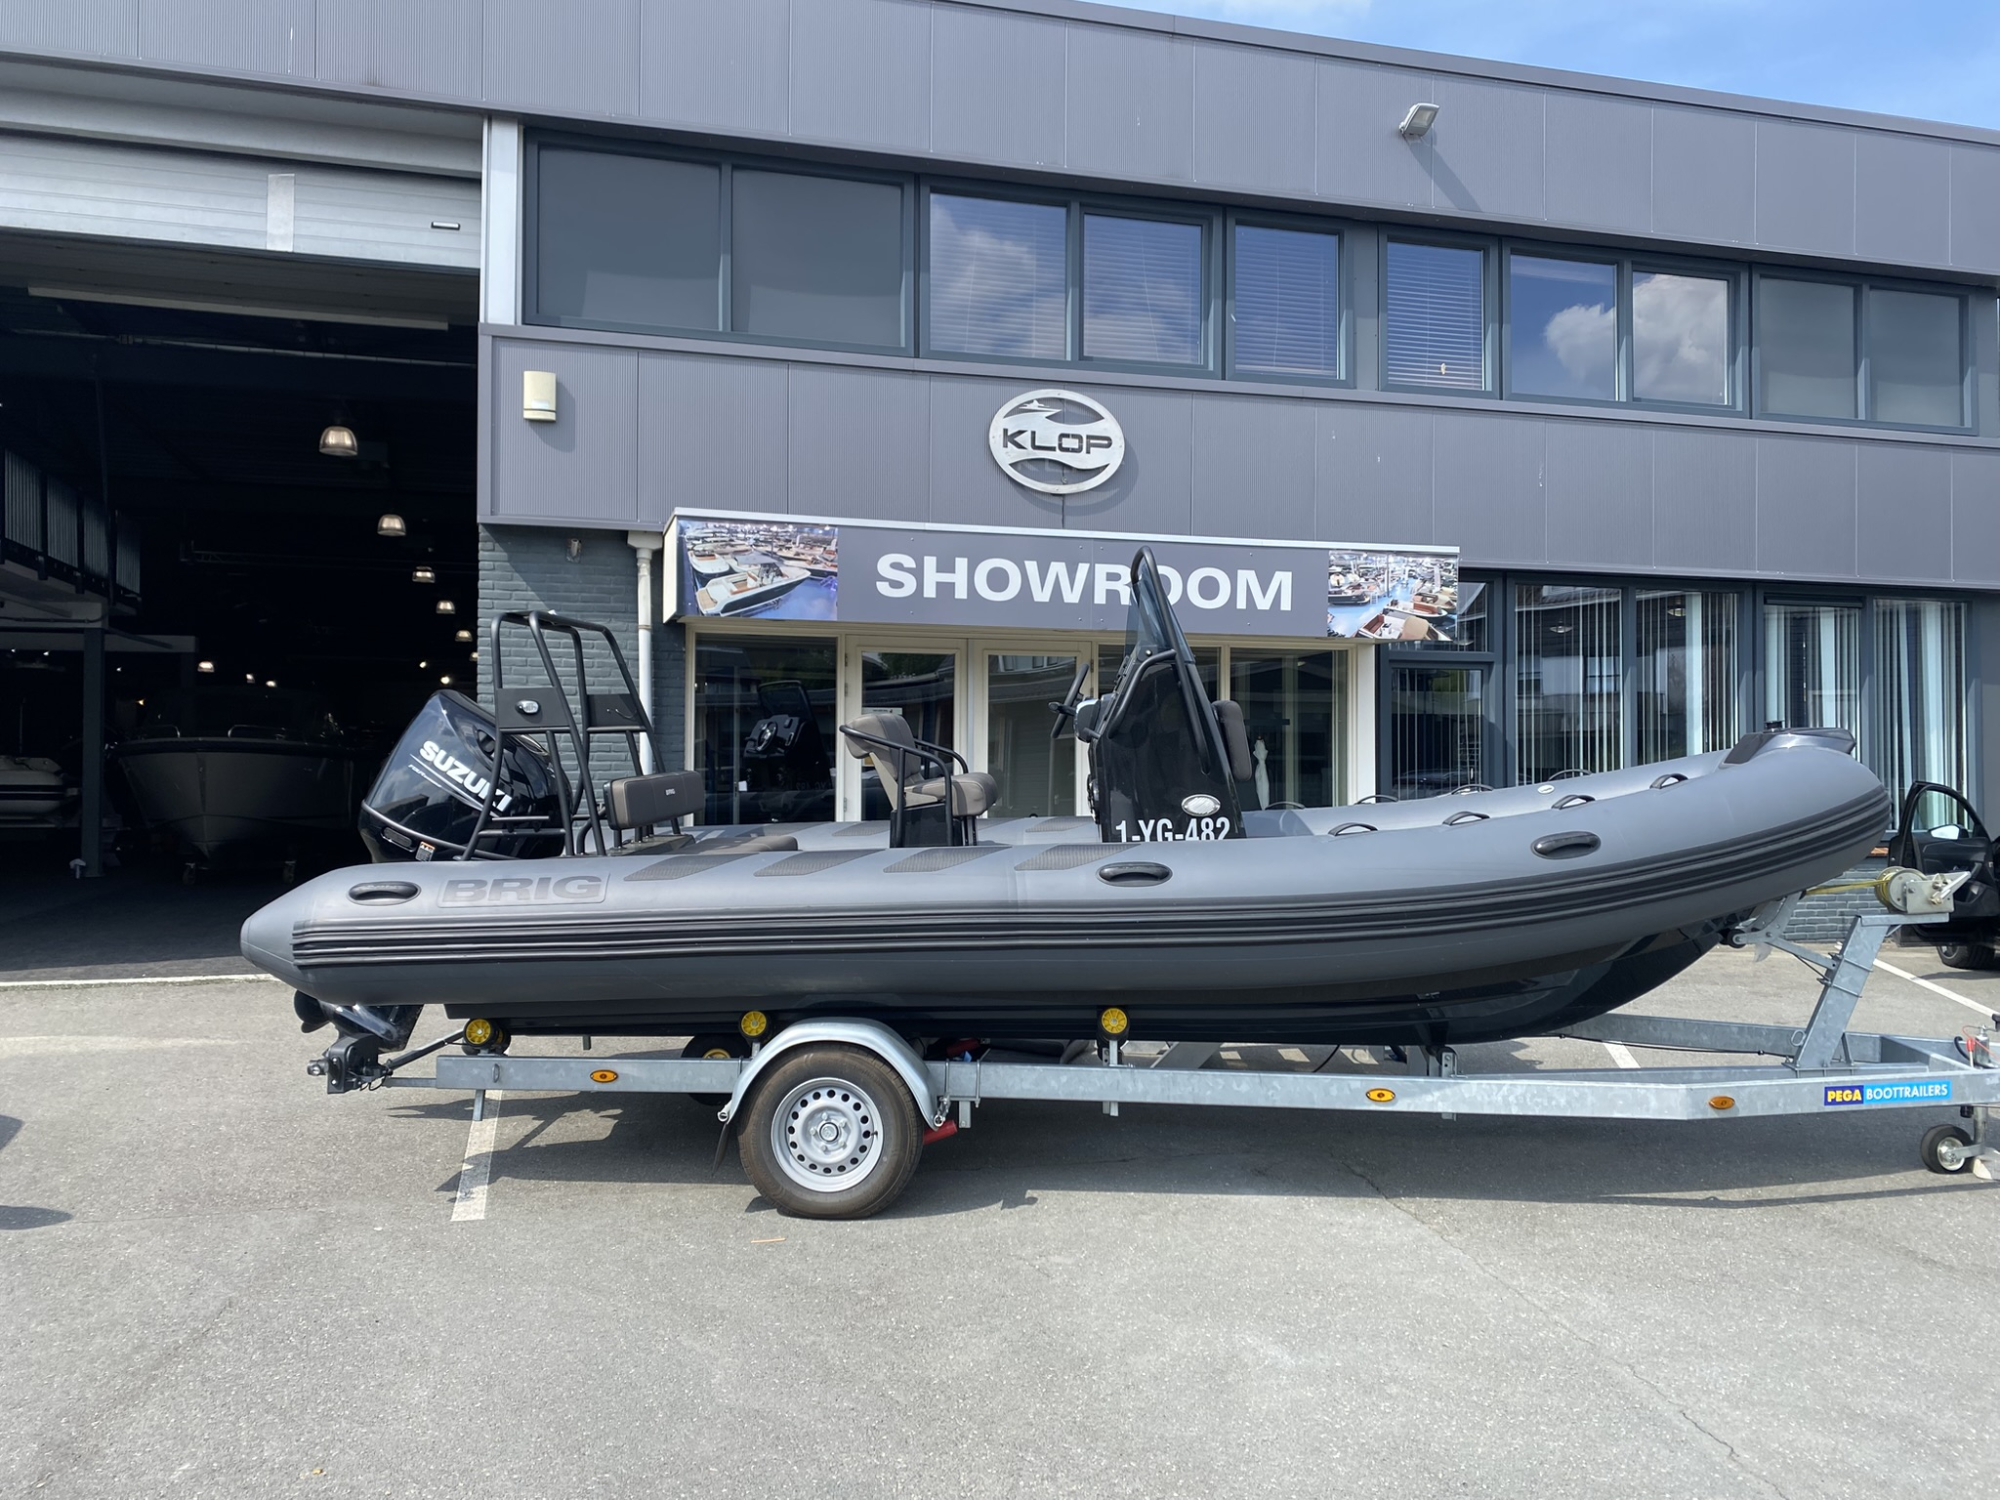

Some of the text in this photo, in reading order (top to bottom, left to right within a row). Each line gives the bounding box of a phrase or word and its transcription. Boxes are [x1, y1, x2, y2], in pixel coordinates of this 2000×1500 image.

[1003, 428, 1112, 454] KLOP
[1116, 817, 1230, 842] 1-YG-482
[442, 876, 602, 903] BRIG
[1827, 1084, 1948, 1102] PEGA BOOTTRAILERS
